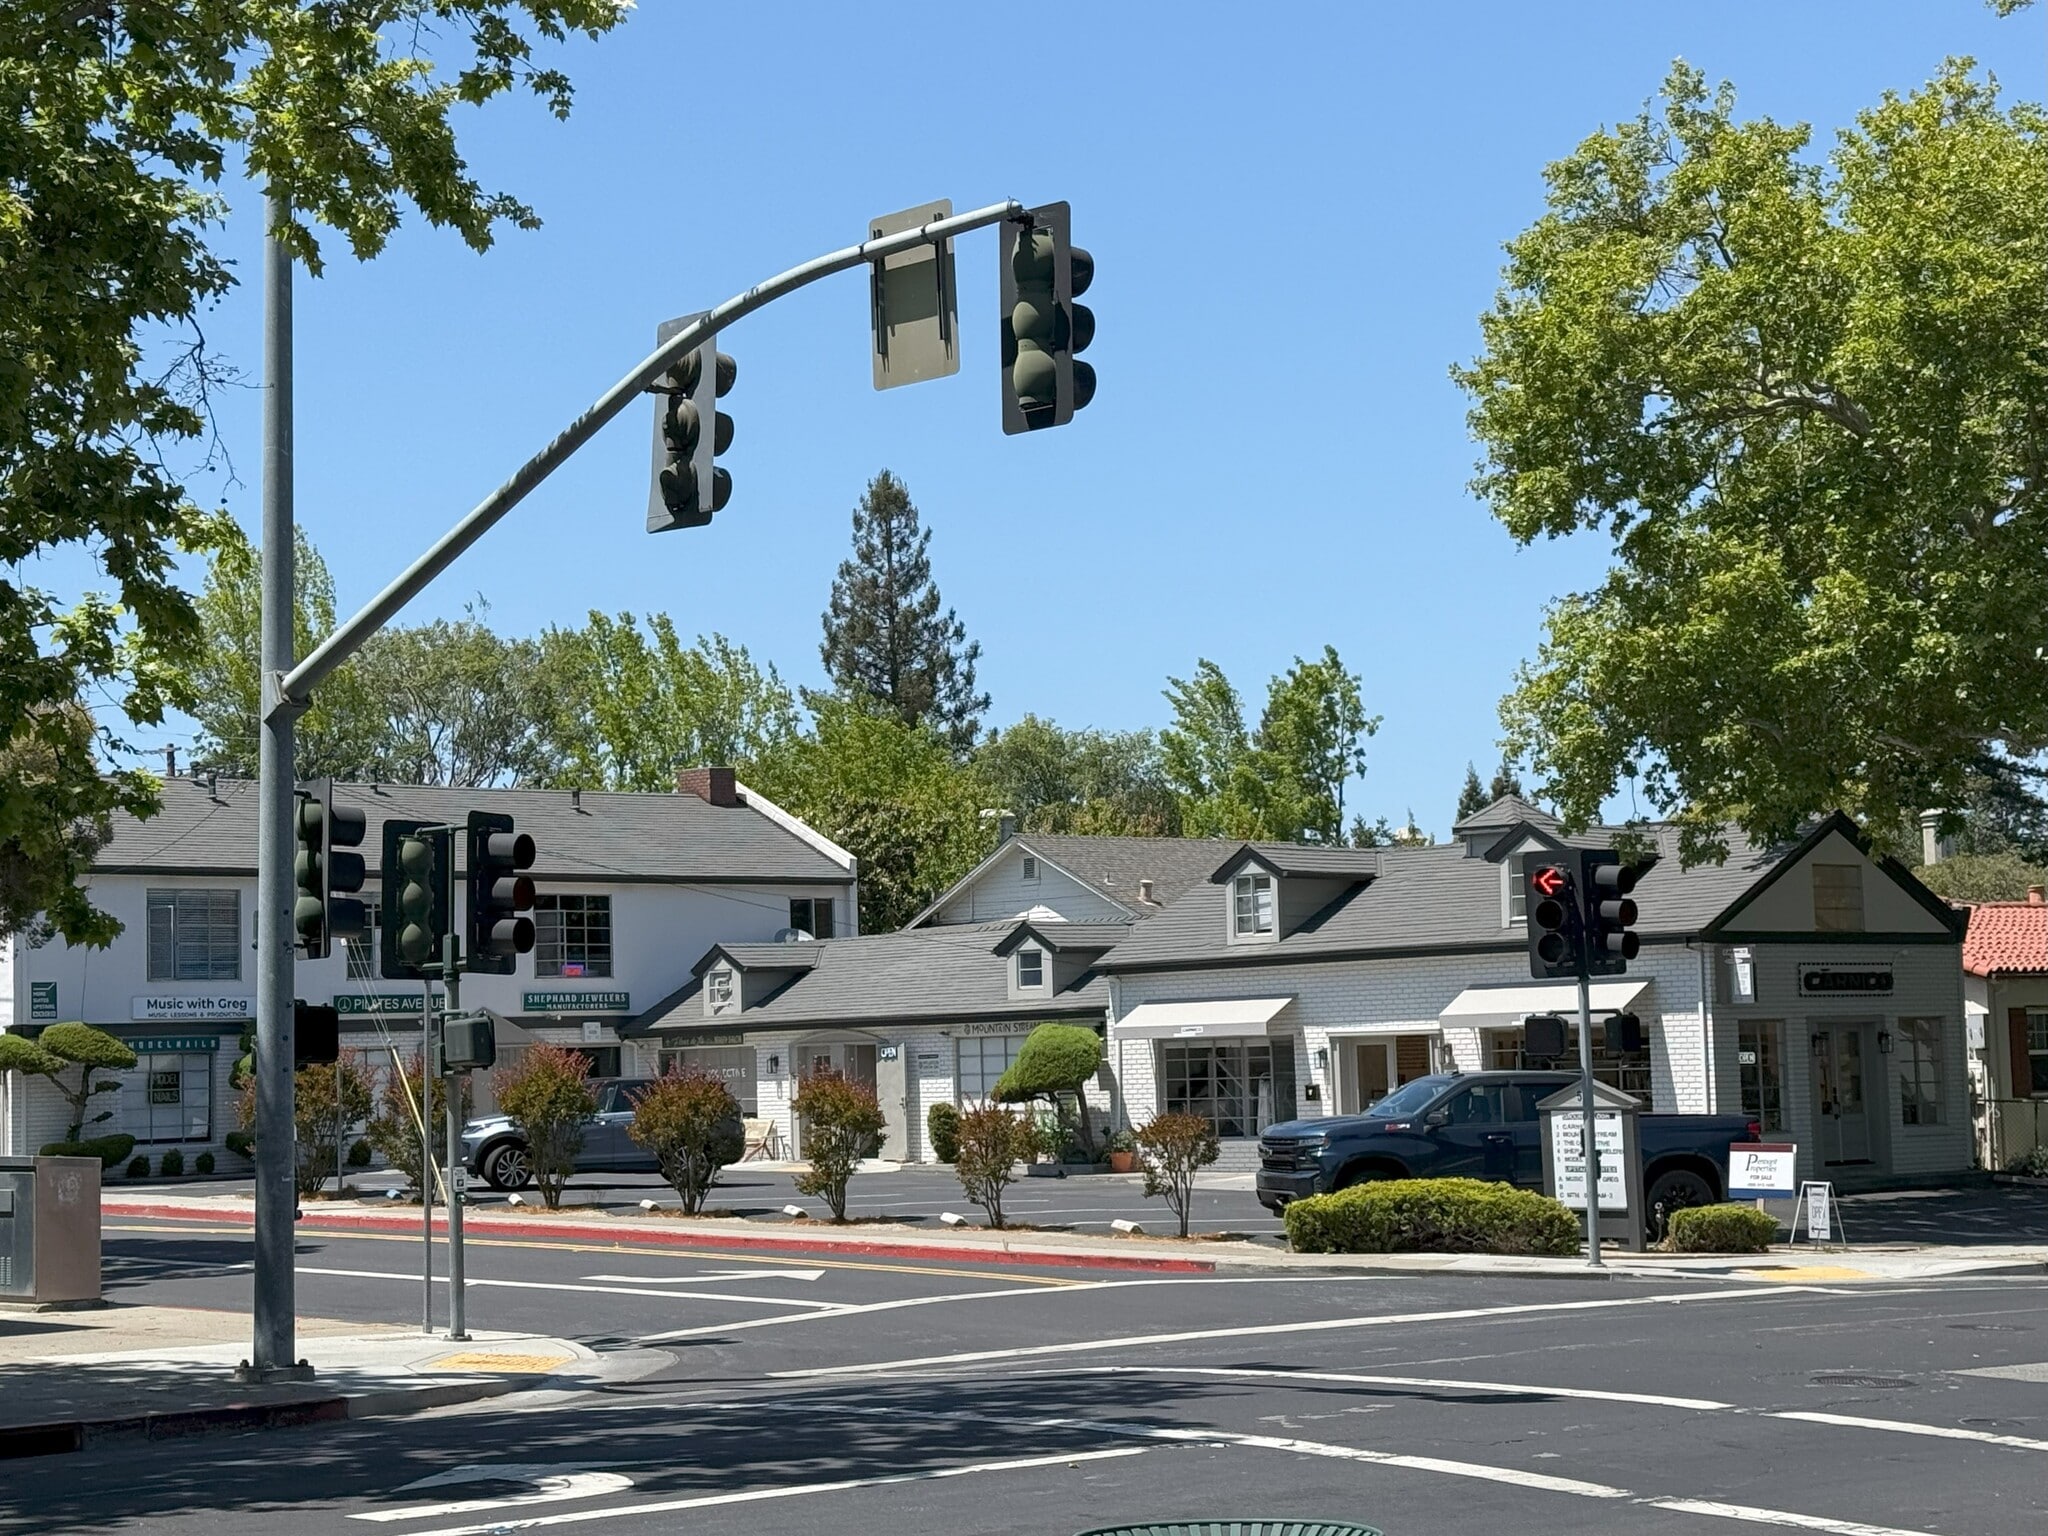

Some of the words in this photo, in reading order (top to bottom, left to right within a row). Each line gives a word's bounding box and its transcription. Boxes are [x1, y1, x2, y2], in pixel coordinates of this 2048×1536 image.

[401, 998, 445, 1009] AVEUE
[527, 994, 577, 1003] SHEPHARD
[580, 993, 626, 1002] JEWELERS
[147, 998, 184, 1010] Music
[186, 998, 215, 1009] with
[218, 999, 248, 1011] Greg
